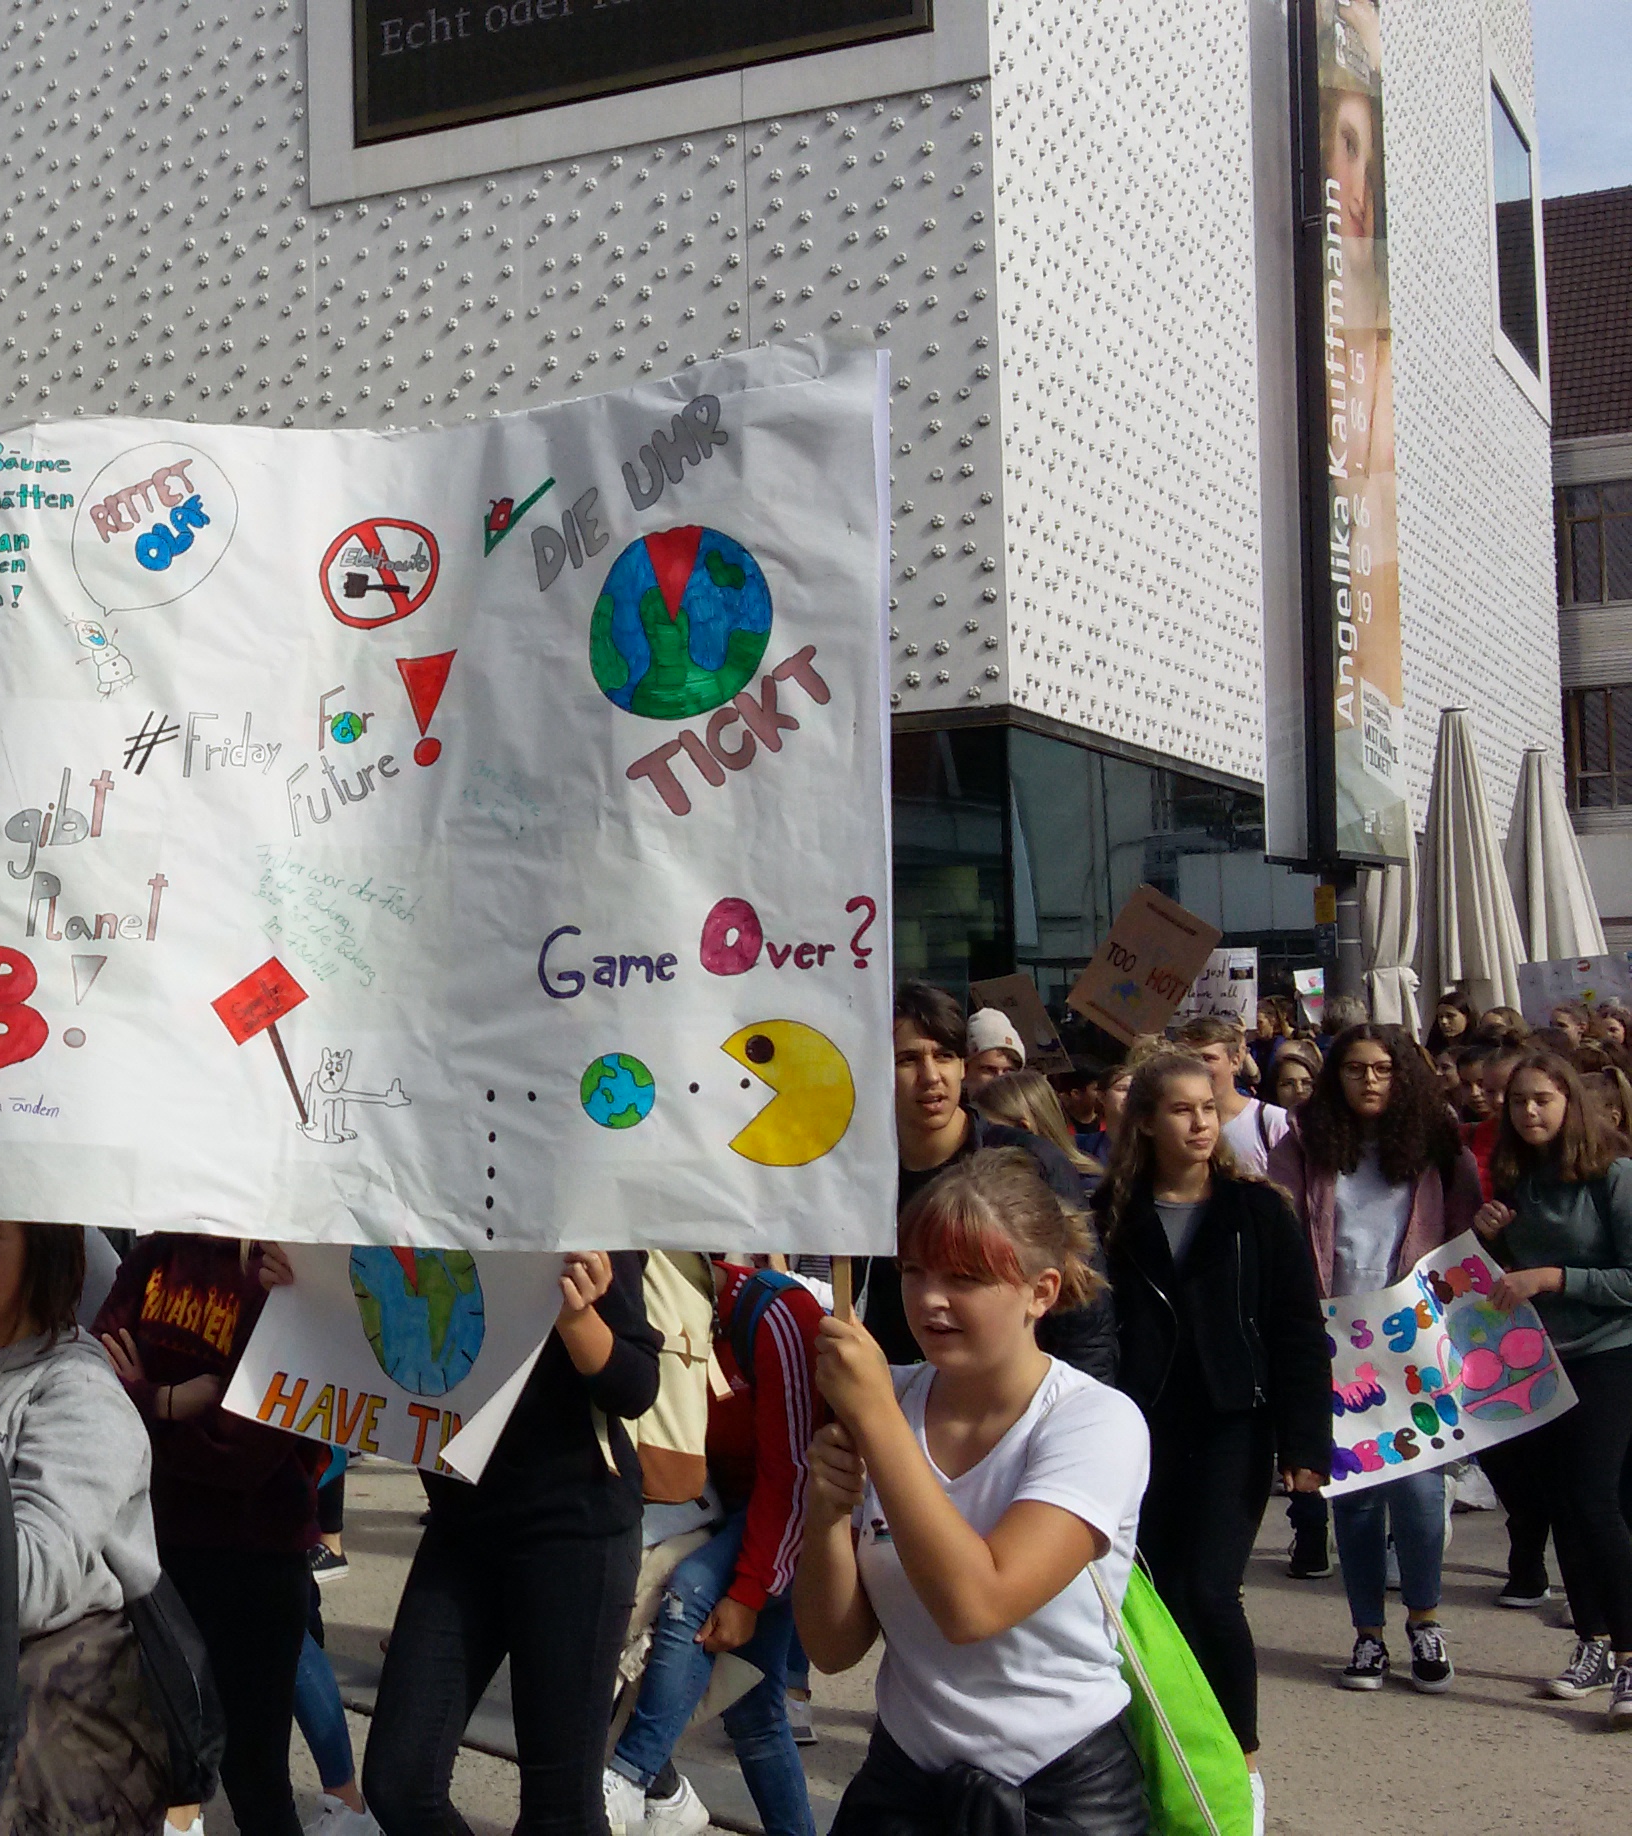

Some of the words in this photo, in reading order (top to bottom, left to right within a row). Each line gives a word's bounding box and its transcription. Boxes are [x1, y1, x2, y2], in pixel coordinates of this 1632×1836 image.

[380, 7, 471, 56] Echt
[1325, 177, 1348, 479] Kauffmann
[1349, 349, 1365, 385] 15
[90, 458, 195, 543] RETTET
[135, 494, 210, 571] OLAF
[531, 487, 609, 591] DIE
[622, 394, 729, 511] UHR
[1331, 495, 1358, 726] Angelika
[1357, 590, 1371, 624] 19
[626, 645, 831, 816] TICKT
[4, 767, 114, 879] gibt
[286, 755, 400, 837] Future
[26, 871, 168, 941] Planet
[538, 925, 678, 999] Game
[1106, 941, 1137, 973] TOO
[256, 1371, 387, 1454] HAVE
